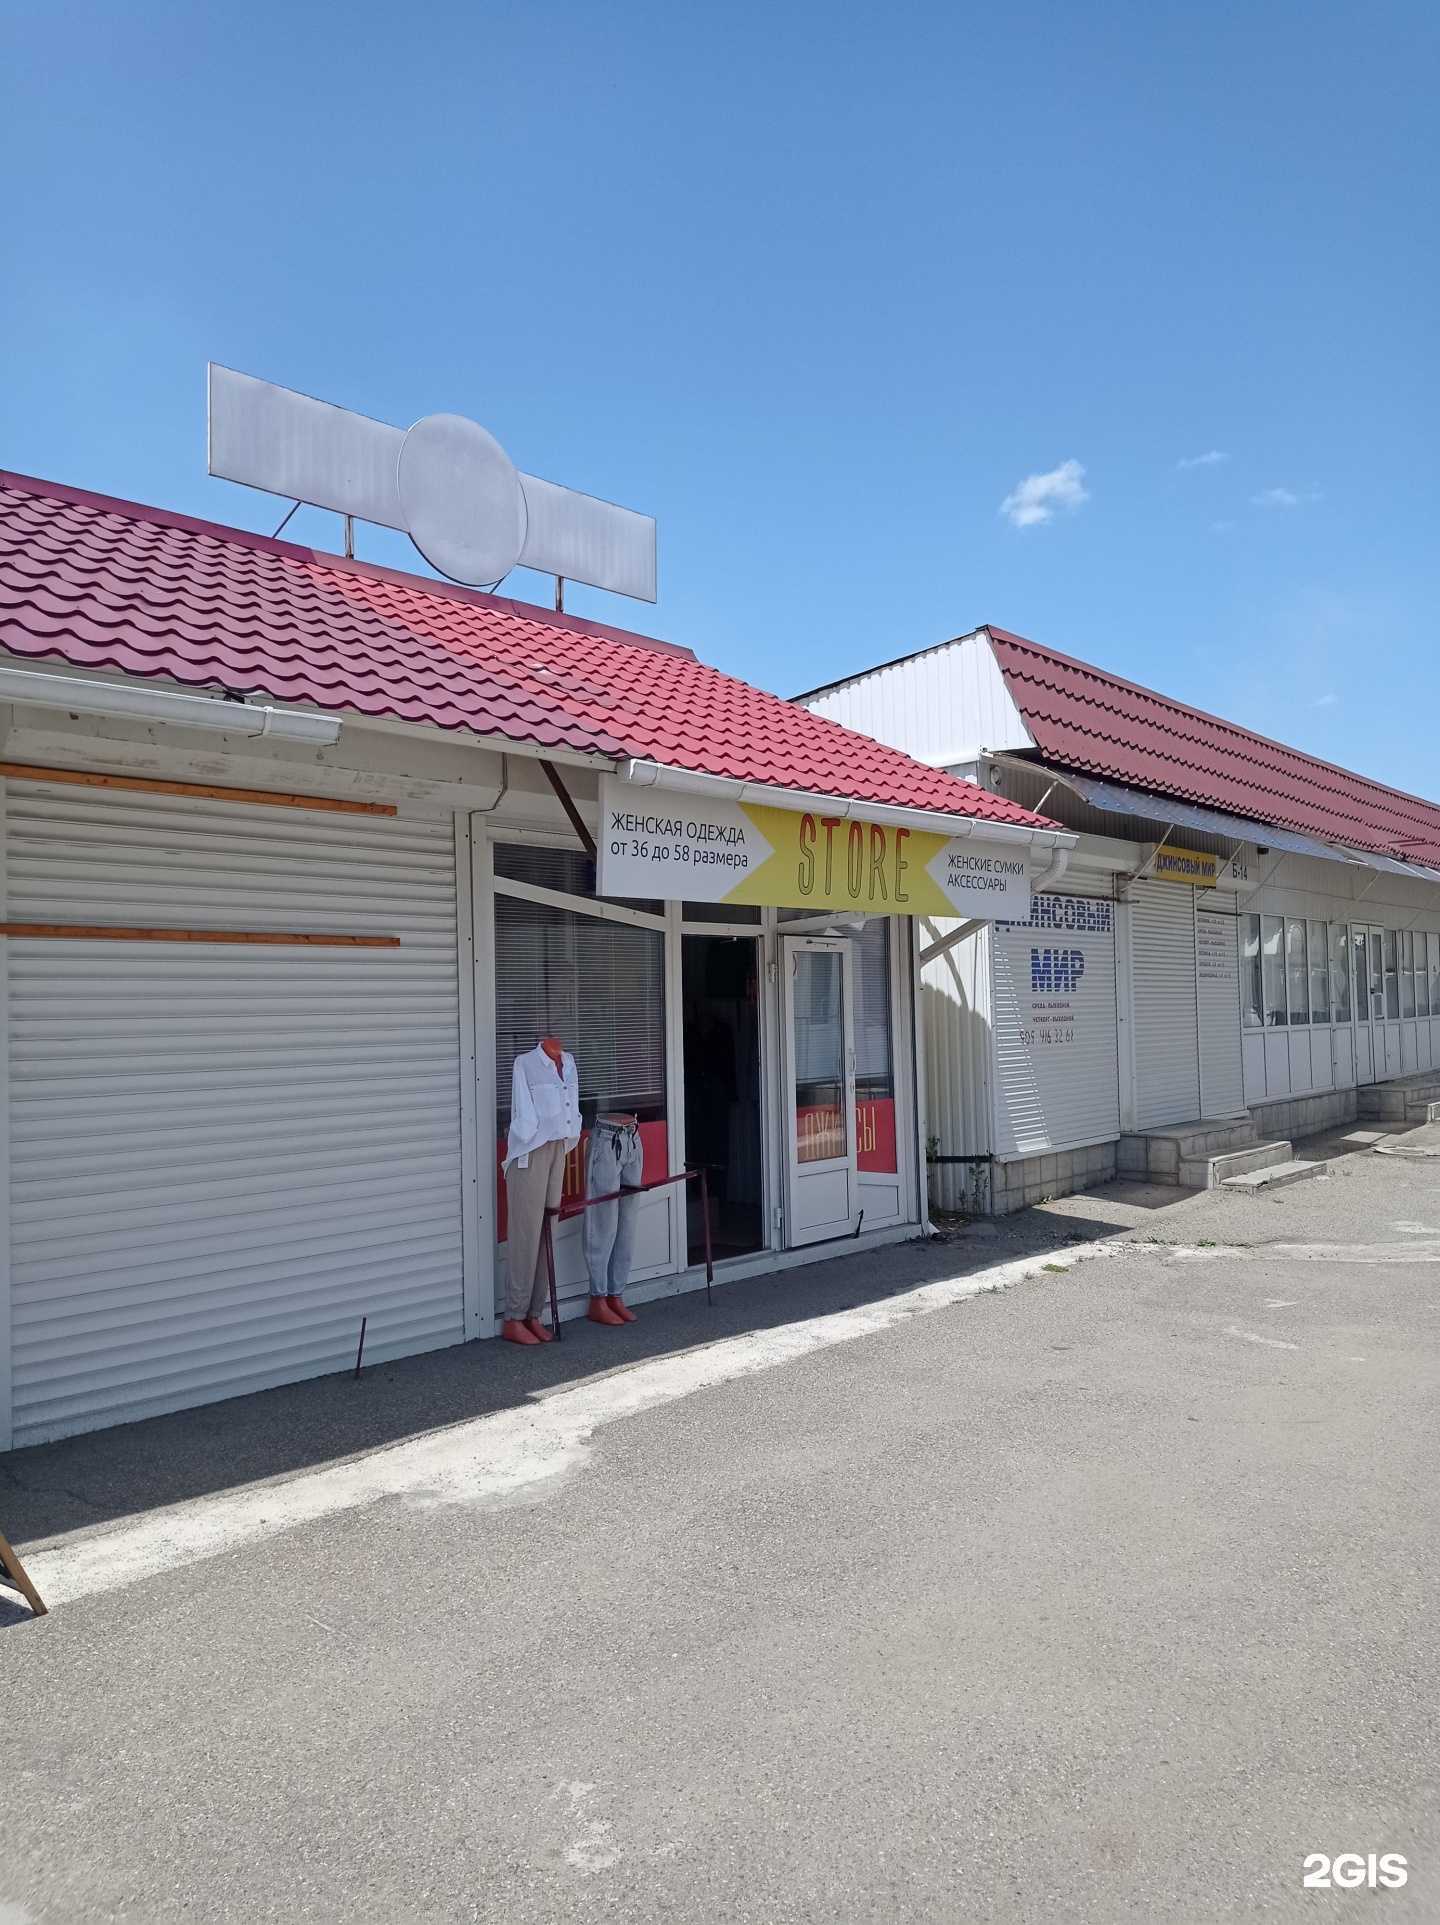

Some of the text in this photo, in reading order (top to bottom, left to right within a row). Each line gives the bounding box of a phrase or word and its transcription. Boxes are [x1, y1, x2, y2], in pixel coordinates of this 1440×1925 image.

[610, 811, 746, 847] ЖЕНСКАЯ ОДЕЖДА
[610, 839, 749, 870] от 36 до 58 размера
[798, 812, 911, 903] STORE
[947, 853, 1025, 876] ЖЕНСКИЕ СУМКИ
[947, 873, 1007, 892] АКСЕССУАРЫ
[1031, 949, 1085, 992] МИР
